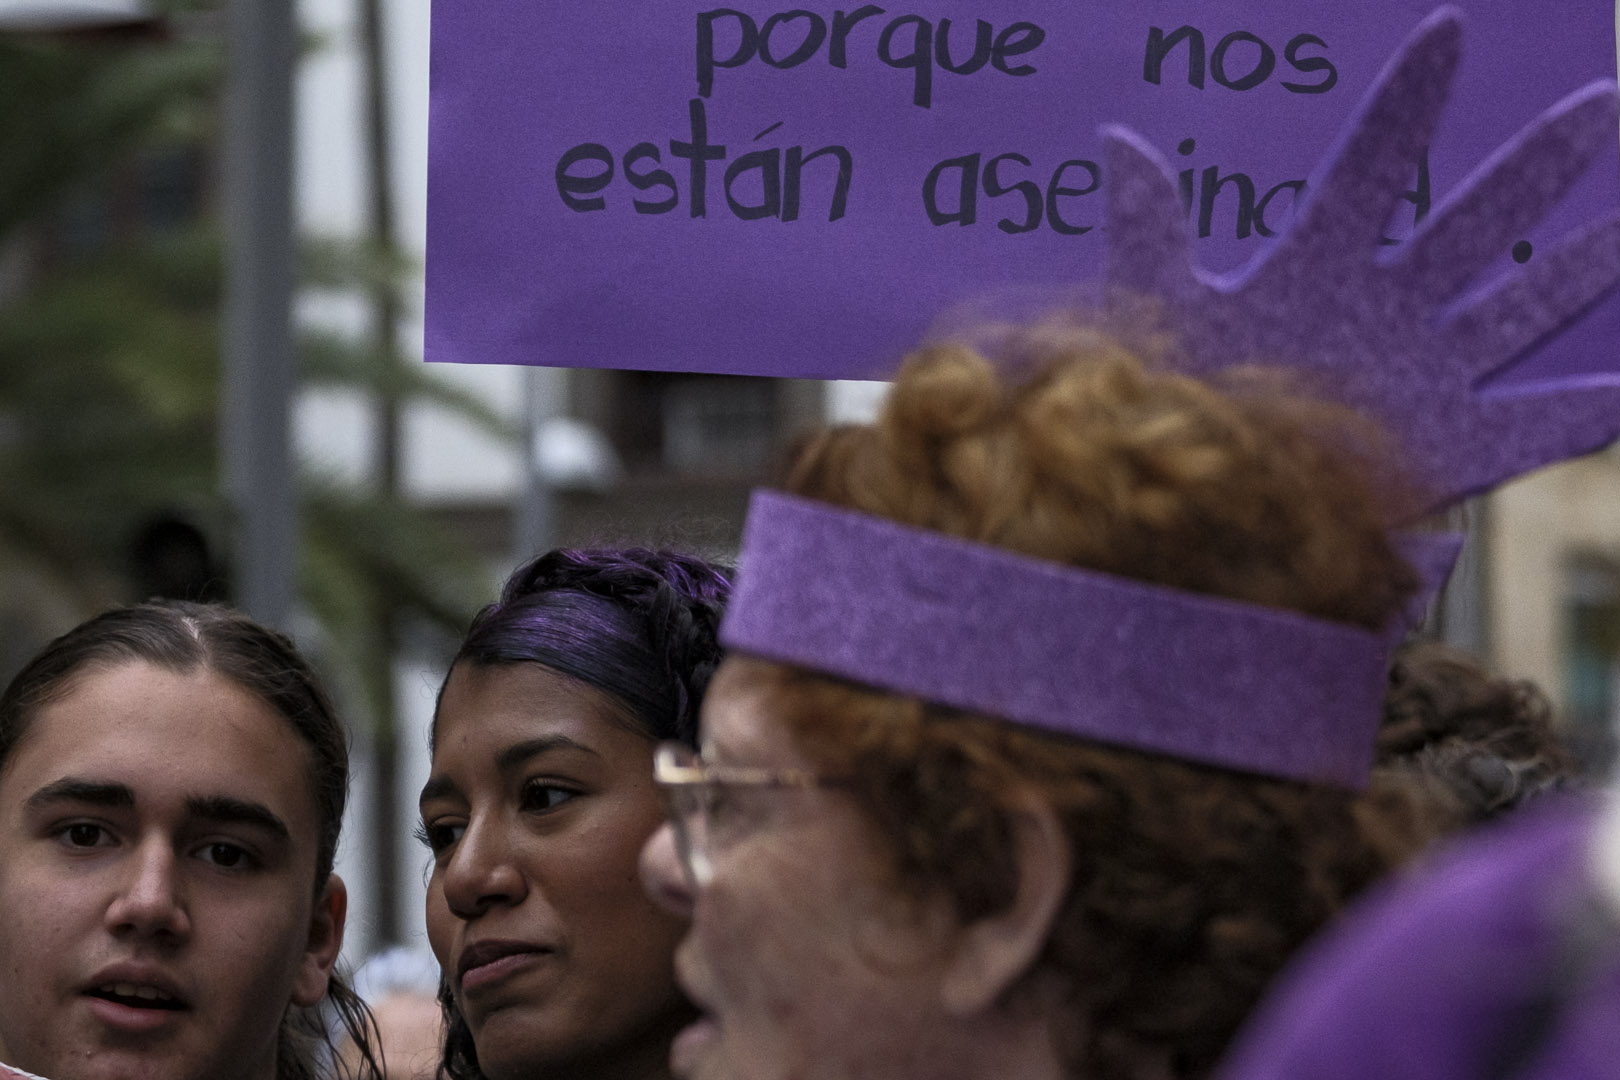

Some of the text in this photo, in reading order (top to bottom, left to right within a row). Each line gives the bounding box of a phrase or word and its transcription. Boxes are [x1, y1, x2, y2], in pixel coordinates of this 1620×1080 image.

[695, 4, 1339, 110] porque nos
[554, 97, 853, 223] están
